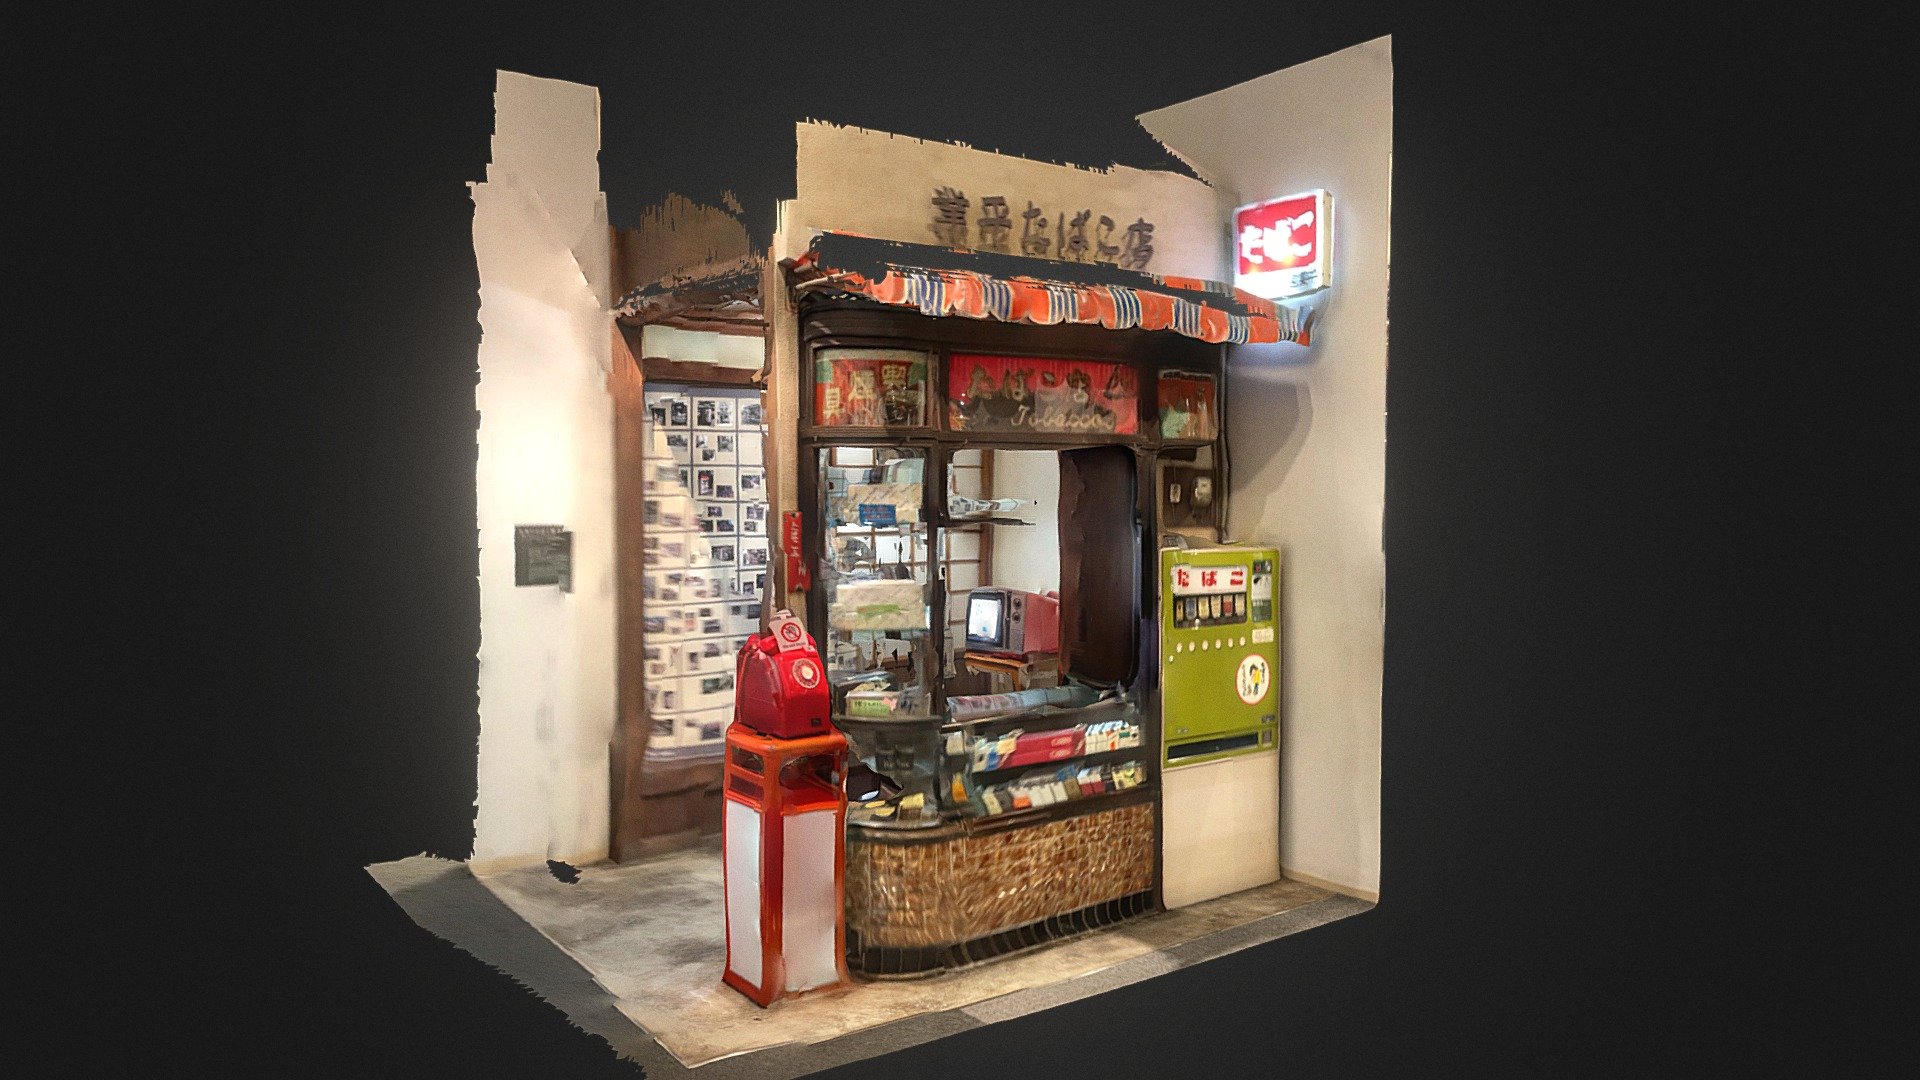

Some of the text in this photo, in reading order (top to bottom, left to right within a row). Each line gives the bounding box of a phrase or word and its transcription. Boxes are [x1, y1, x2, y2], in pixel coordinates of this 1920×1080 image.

[930, 186, 1156, 270] 業平たばこ店
[1240, 211, 1315, 264] たばこ
[1011, 405, 1116, 431] Tobacco
[1177, 568, 1244, 588] たばこ
